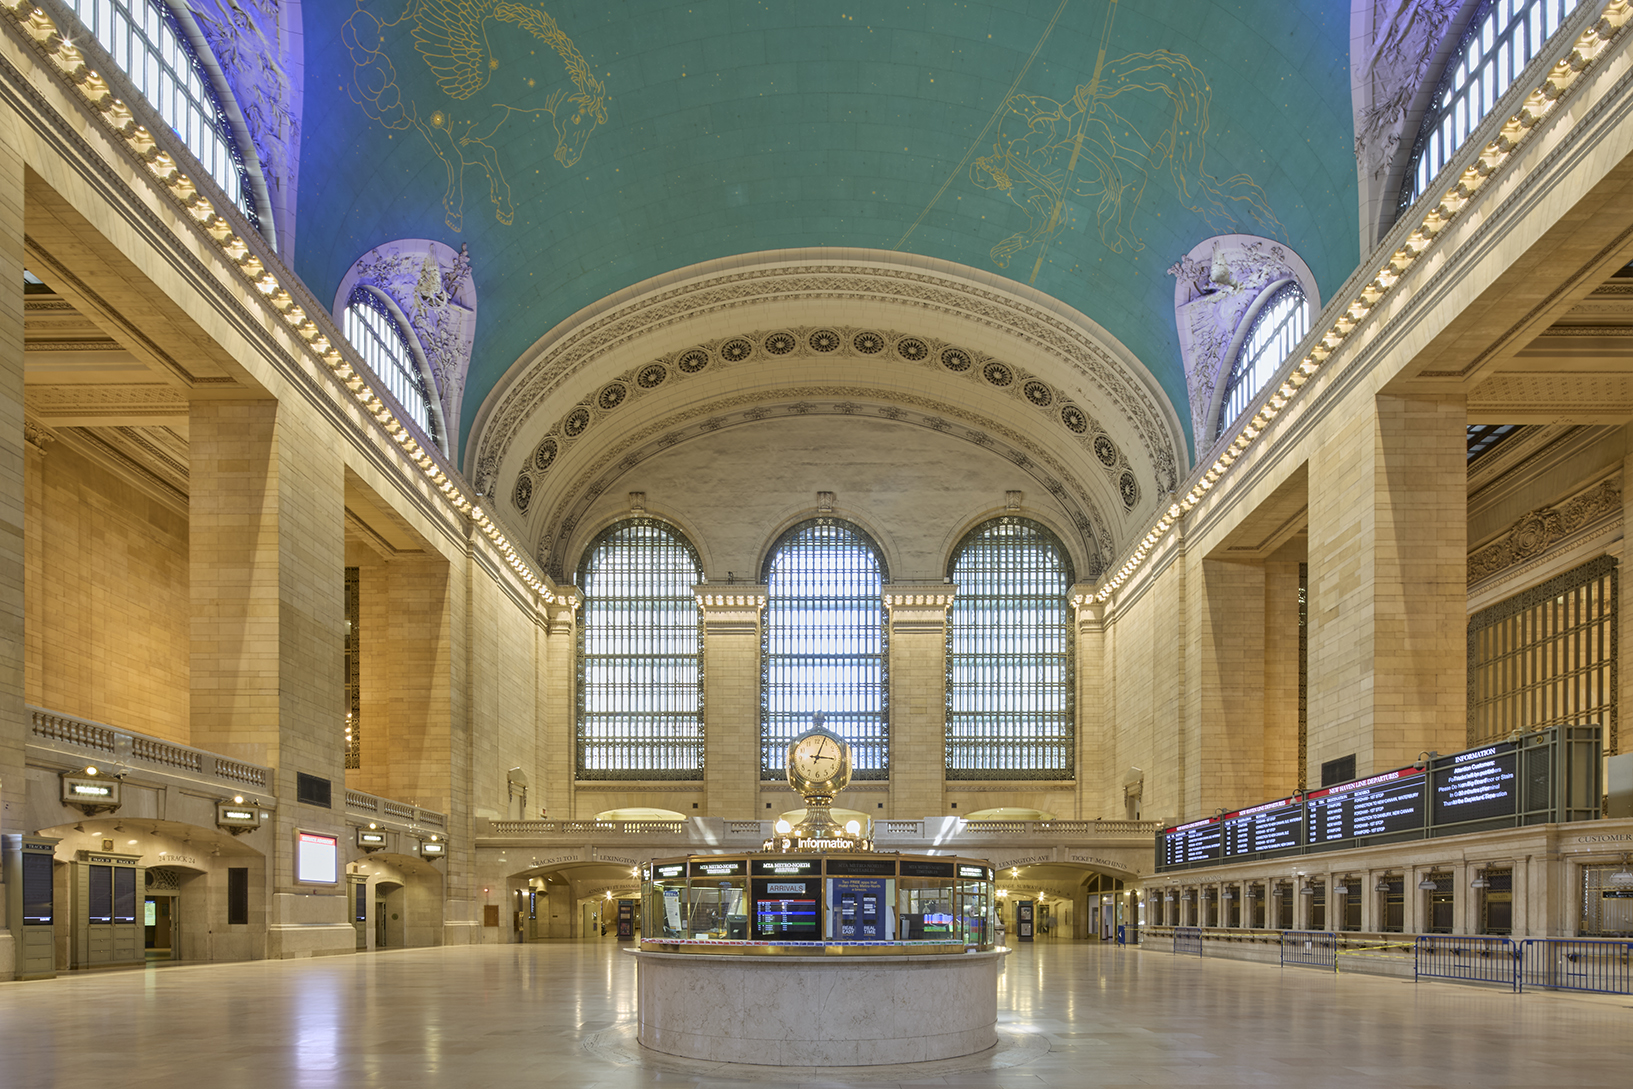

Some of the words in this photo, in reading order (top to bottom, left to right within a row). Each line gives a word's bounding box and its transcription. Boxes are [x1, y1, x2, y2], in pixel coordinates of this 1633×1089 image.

[1455, 748, 1496, 763] INFORMATION
[1454, 766, 1471, 774] Attention
[1340, 783, 1355, 791] HAVEN
[1356, 780, 1367, 788] LINE
[1367, 772, 1399, 785] DEPARTURES
[798, 838, 853, 848] Information
[1578, 834, 1632, 843] CUSTOMER
[600, 855, 637, 865] LEXINGTON
[998, 856, 1036, 867] LEXINGTON
[1095, 857, 1128, 869] MACHINES
